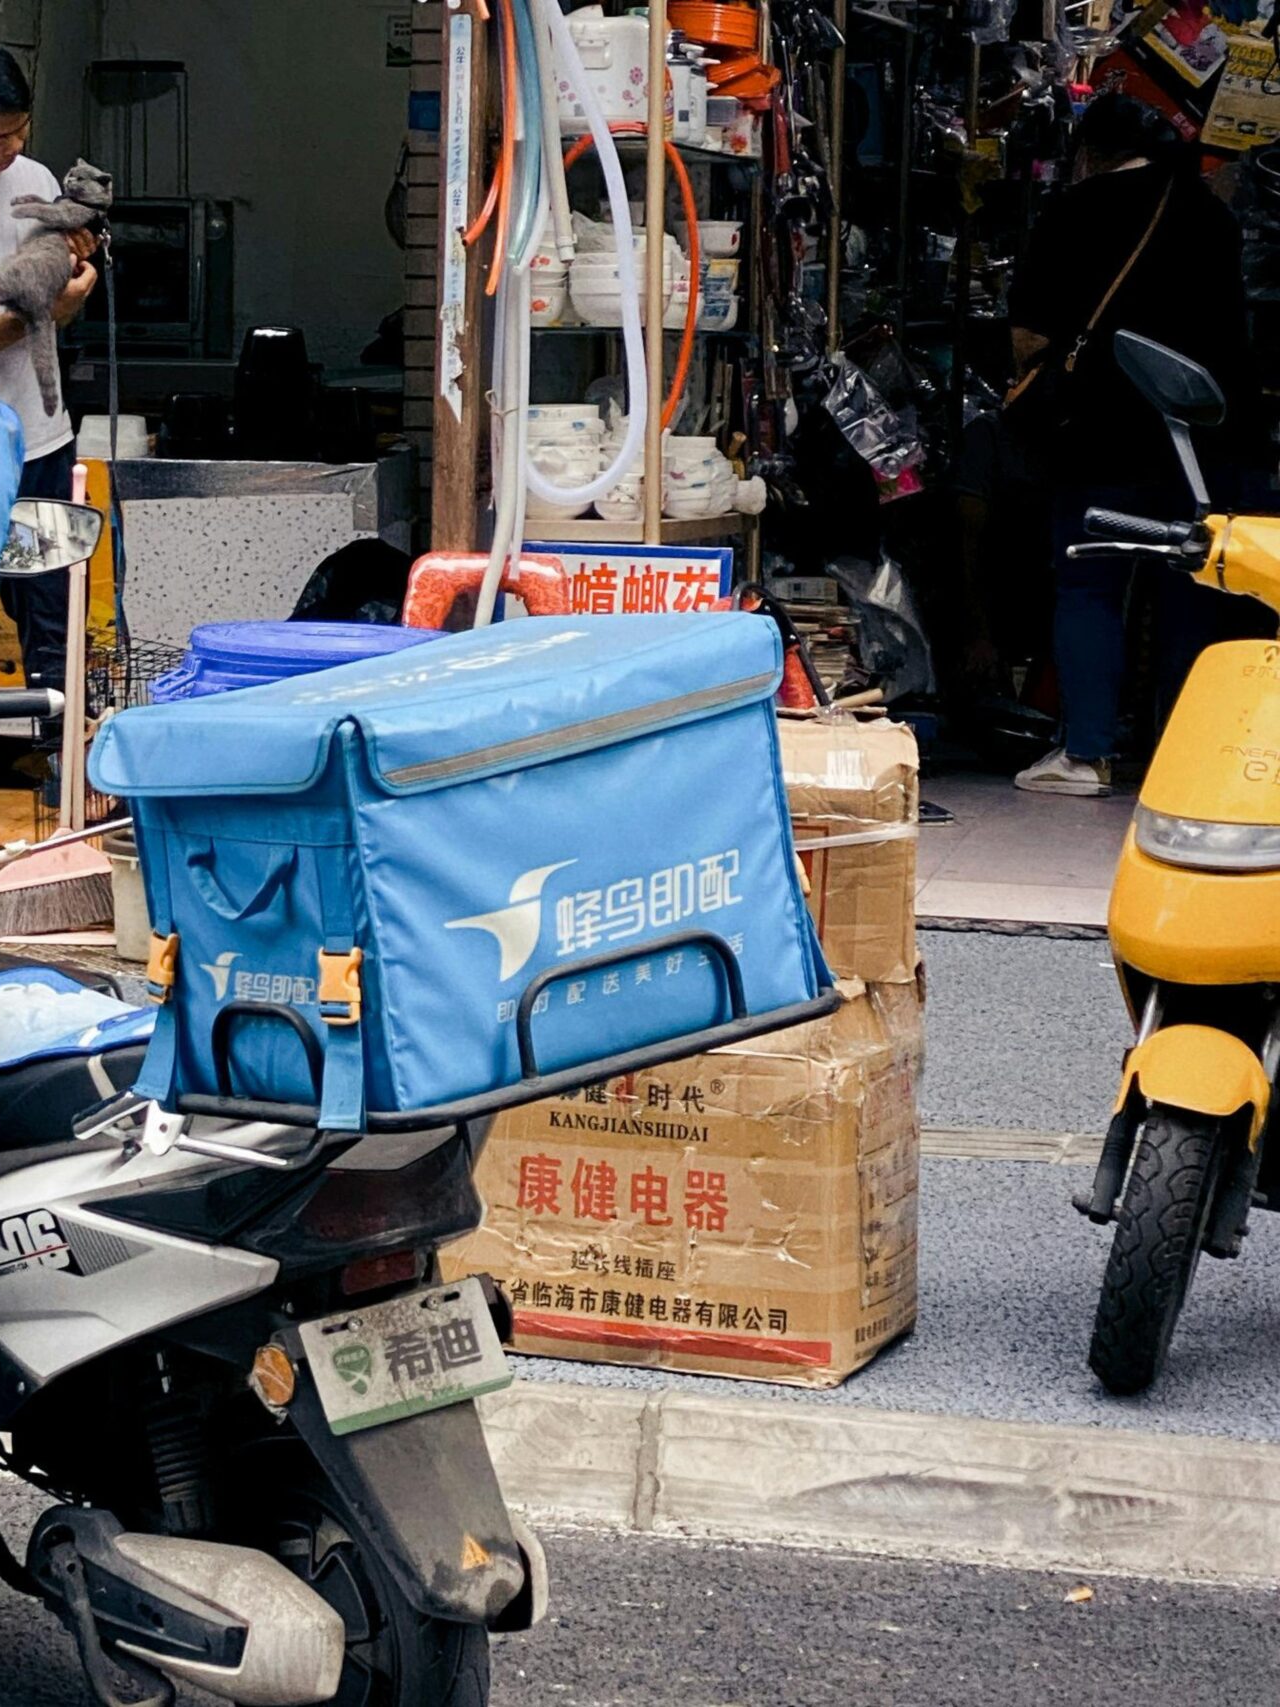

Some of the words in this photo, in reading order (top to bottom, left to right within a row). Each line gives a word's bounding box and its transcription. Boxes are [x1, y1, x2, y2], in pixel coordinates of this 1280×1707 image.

[567, 562, 720, 614] 蟑螂药
[555, 848, 744, 957] 蜂鸟即配
[548, 1109, 710, 1144] KANGJIANSHIDAI
[647, 1082, 706, 1114] 时代
[515, 1151, 731, 1234] 康健电器
[484, 1274, 789, 1335] 省临海市康健电器有限公司
[383, 1317, 484, 1387] 希迪
